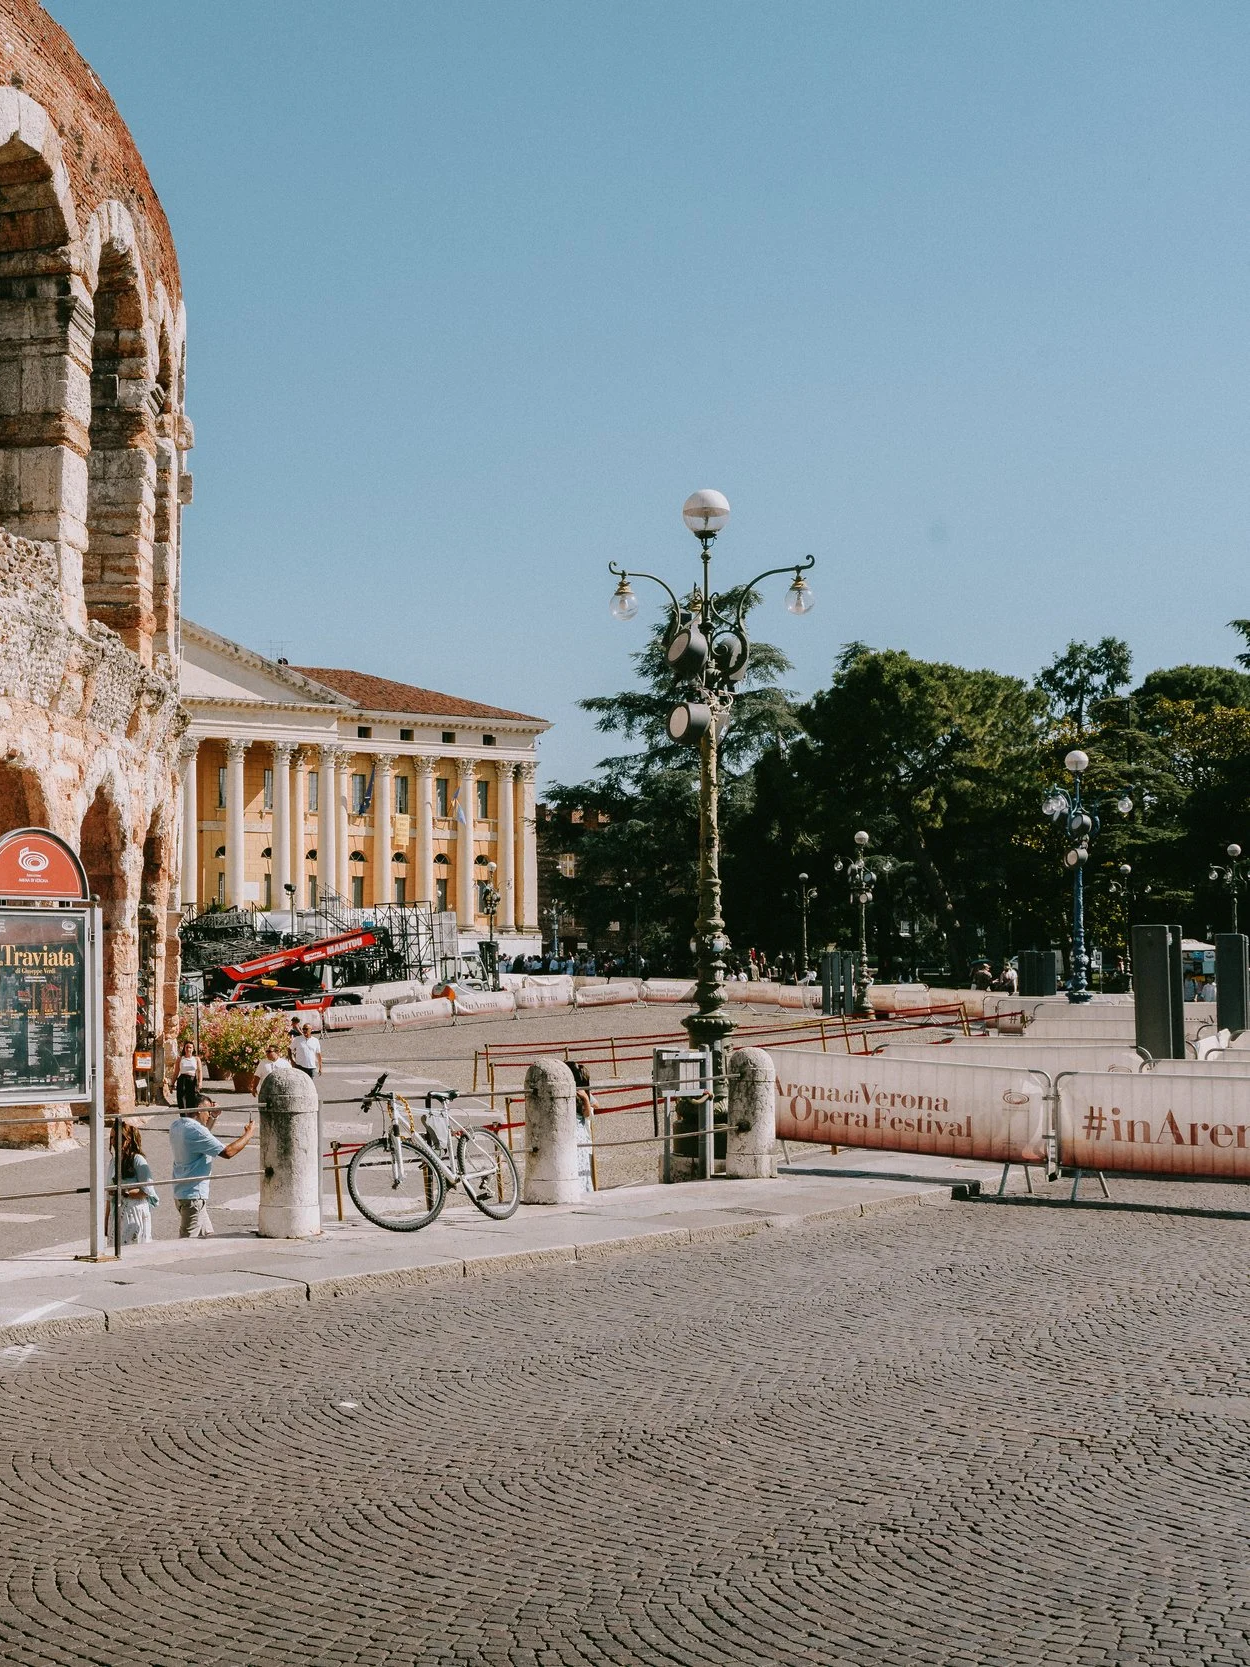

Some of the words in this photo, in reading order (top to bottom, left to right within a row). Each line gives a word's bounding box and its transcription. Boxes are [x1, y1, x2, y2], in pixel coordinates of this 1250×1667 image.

[326, 938, 363, 955] MANITOU
[1, 945, 75, 966] Traviata
[21, 968, 43, 976] Giuseppe
[330, 1013, 367, 1022] #inArena
[396, 1009, 434, 1020] #inArena
[775, 1076, 841, 1102] Arena
[844, 1090, 859, 1103] di
[860, 1083, 950, 1112] Verona
[790, 1096, 869, 1130] Opera
[874, 1108, 972, 1137] Festival
